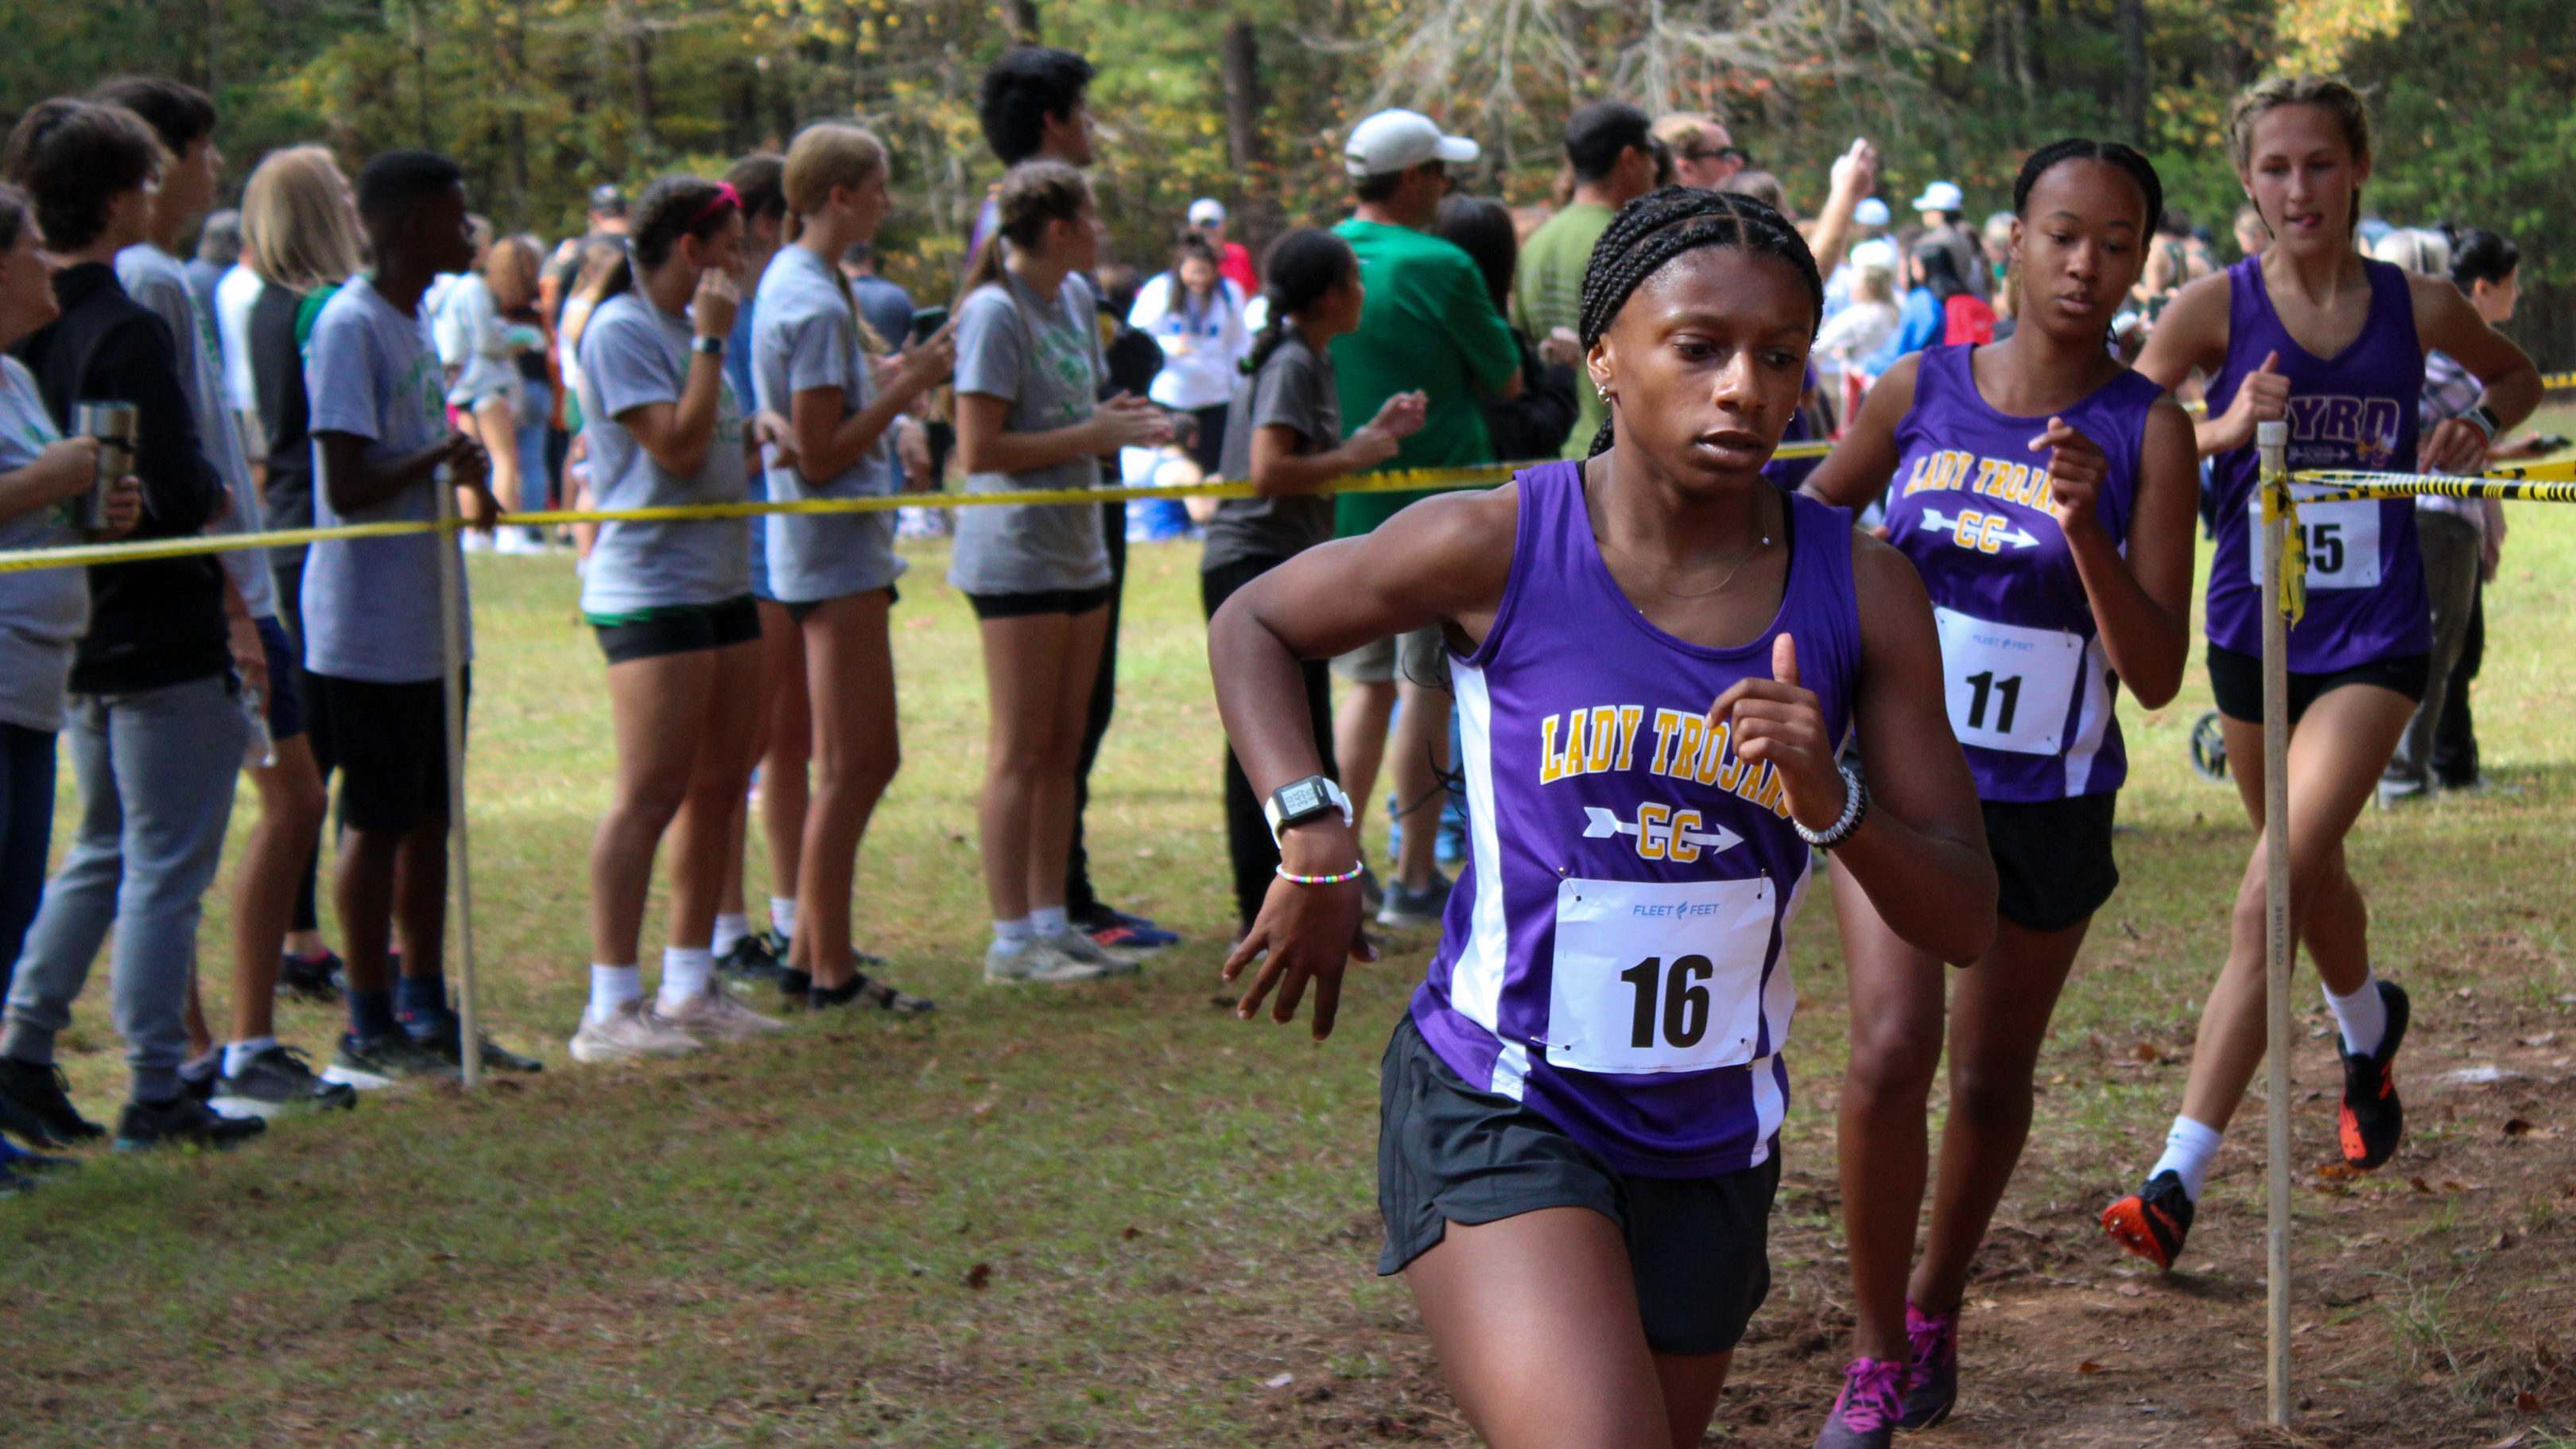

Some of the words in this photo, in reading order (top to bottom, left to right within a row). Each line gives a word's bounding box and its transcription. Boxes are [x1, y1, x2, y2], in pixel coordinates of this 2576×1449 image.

[2283, 395, 2400, 444] YRD
[1903, 449, 1975, 499] LADY
[1972, 456, 2058, 519] TROJA
[1953, 508, 2008, 554] CC
[1966, 671, 2022, 733] 11
[1540, 705, 1644, 785] LADY
[1635, 802, 1702, 864] CC
[1633, 905, 1674, 916] FLEET
[1690, 903, 1720, 915] FEET
[1621, 954, 1713, 1048] 16
